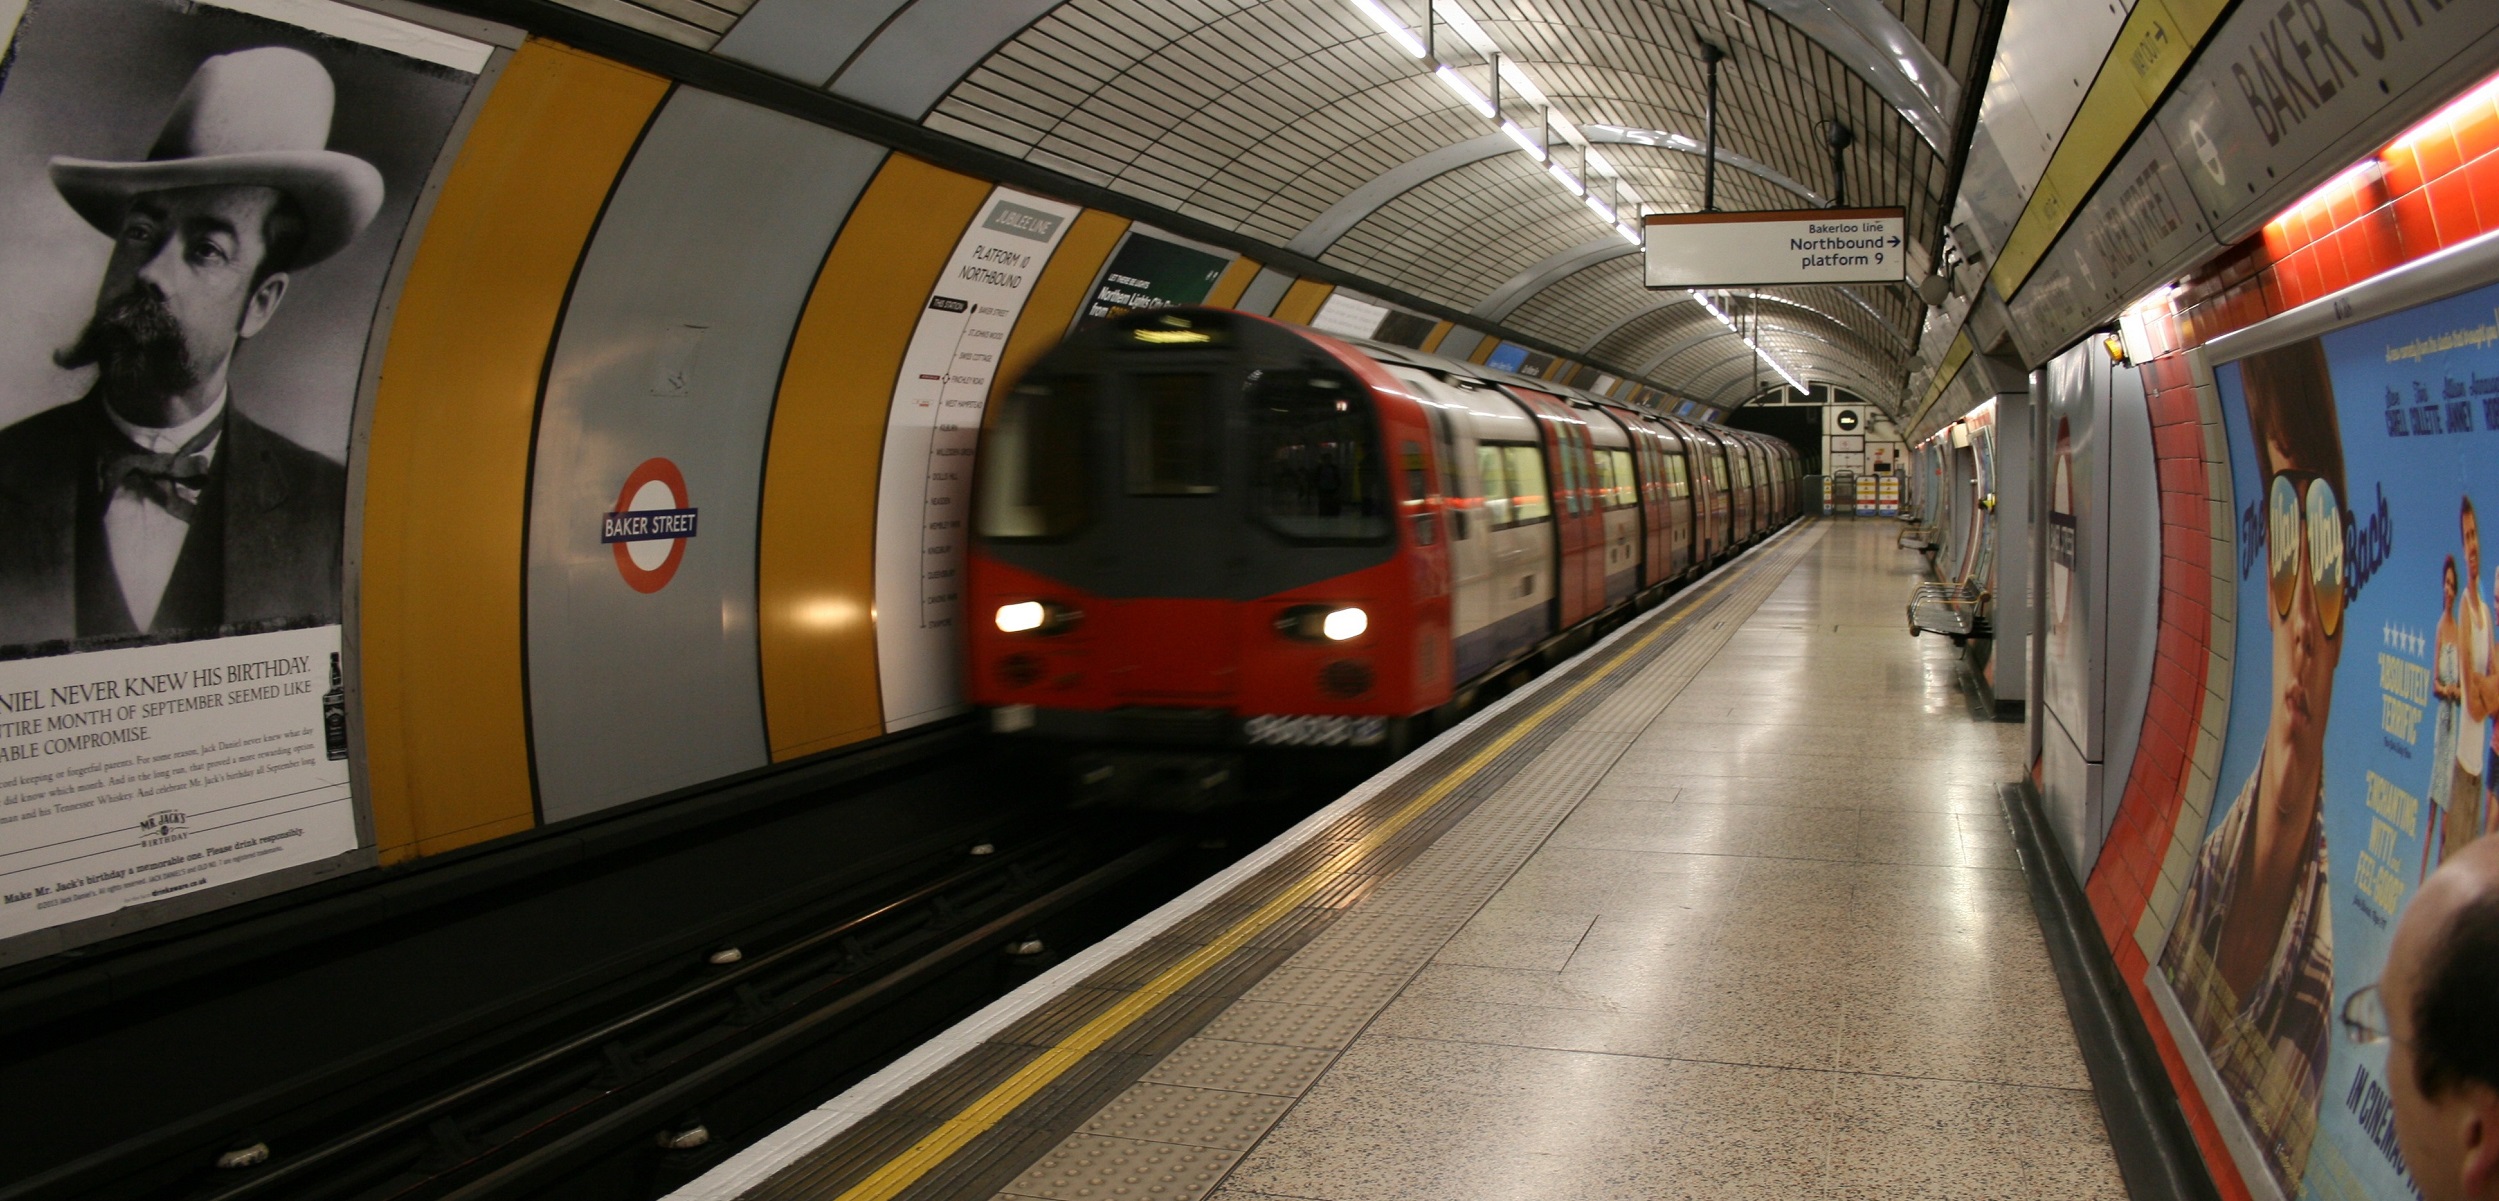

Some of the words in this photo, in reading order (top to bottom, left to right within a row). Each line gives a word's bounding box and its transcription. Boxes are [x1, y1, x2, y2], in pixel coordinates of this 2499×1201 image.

[2231, 0, 2359, 147] BAKER
[995, 209, 1033, 230] JUBILEE
[1028, 217, 1052, 235] LINE
[1809, 224, 1858, 234] Bakerloo
[1863, 223, 1884, 233] line
[972, 245, 1021, 267] PLATFORM
[1790, 236, 1884, 251] Northbound
[1802, 253, 1869, 270] platform
[1875, 253, 1884, 265] 9
[958, 265, 1022, 289] NORTHBOUND
[1089, 302, 1109, 318] from
[1098, 286, 1131, 304] Northern
[1128, 292, 1151, 309] Lights
[605, 517, 648, 537] BAKER
[651, 514, 696, 534] STREET
[2243, 500, 2266, 581] The
[2270, 492, 2300, 578] Way
[2307, 495, 2343, 586] Way
[2343, 481, 2392, 609] Back
[51, 680, 120, 708] NEVER
[125, 671, 188, 697] KNEW
[193, 667, 223, 688] HIS
[227, 656, 311, 684] BIRTHDAY.
[47, 708, 113, 732] MONTH
[117, 705, 137, 722] OF
[142, 693, 224, 719] SEPTEMBER
[228, 685, 280, 706] SEEMED
[284, 680, 312, 697] LIKE
[44, 726, 151, 756] COMPROMISE.
[19, 772, 53, 786] keeping
[55, 771, 65, 779] or
[66, 762, 102, 778] forgetful
[103, 759, 133, 773] parents.
[136, 755, 150, 764] For
[152, 753, 171, 763] some
[200, 744, 216, 756] Jack
[218, 738, 241, 751] Daniel
[243, 737, 262, 746] never
[263, 734, 282, 743] knew
[284, 729, 301, 738] what
[301, 727, 314, 736] day
[4, 795, 18, 806] did
[20, 791, 46, 803] know
[48, 784, 75, 797] which
[109, 774, 126, 786] And
[127, 774, 136, 783] in
[137, 771, 151, 781] the
[153, 769, 171, 780] long
[189, 762, 205, 771] that
[207, 756, 231, 770] proved
[238, 754, 256, 763] more
[257, 747, 292, 758] rewarding
[21, 808, 37, 820] and
[39, 807, 51, 817] his
[53, 799, 95, 813] Tennessee
[137, 787, 154, 798] And
[156, 782, 188, 795] celebrate
[204, 774, 225, 787] Jack's
[226, 769, 255, 781] birthday
[256, 766, 265, 775] all
[266, 760, 300, 774] September
[158, 812, 186, 825] JACK'S
[141, 832, 188, 848] BIRTHDAY
[4, 891, 33, 904] Make
[34, 886, 52, 897] Mr.
[56, 879, 84, 892] Jack's
[86, 869, 127, 885] birthday
[136, 856, 185, 873] memorable
[186, 852, 205, 861] one.
[206, 844, 233, 856] Please
[234, 838, 257, 851] drink
[2346, 1064, 2369, 1114] IN
